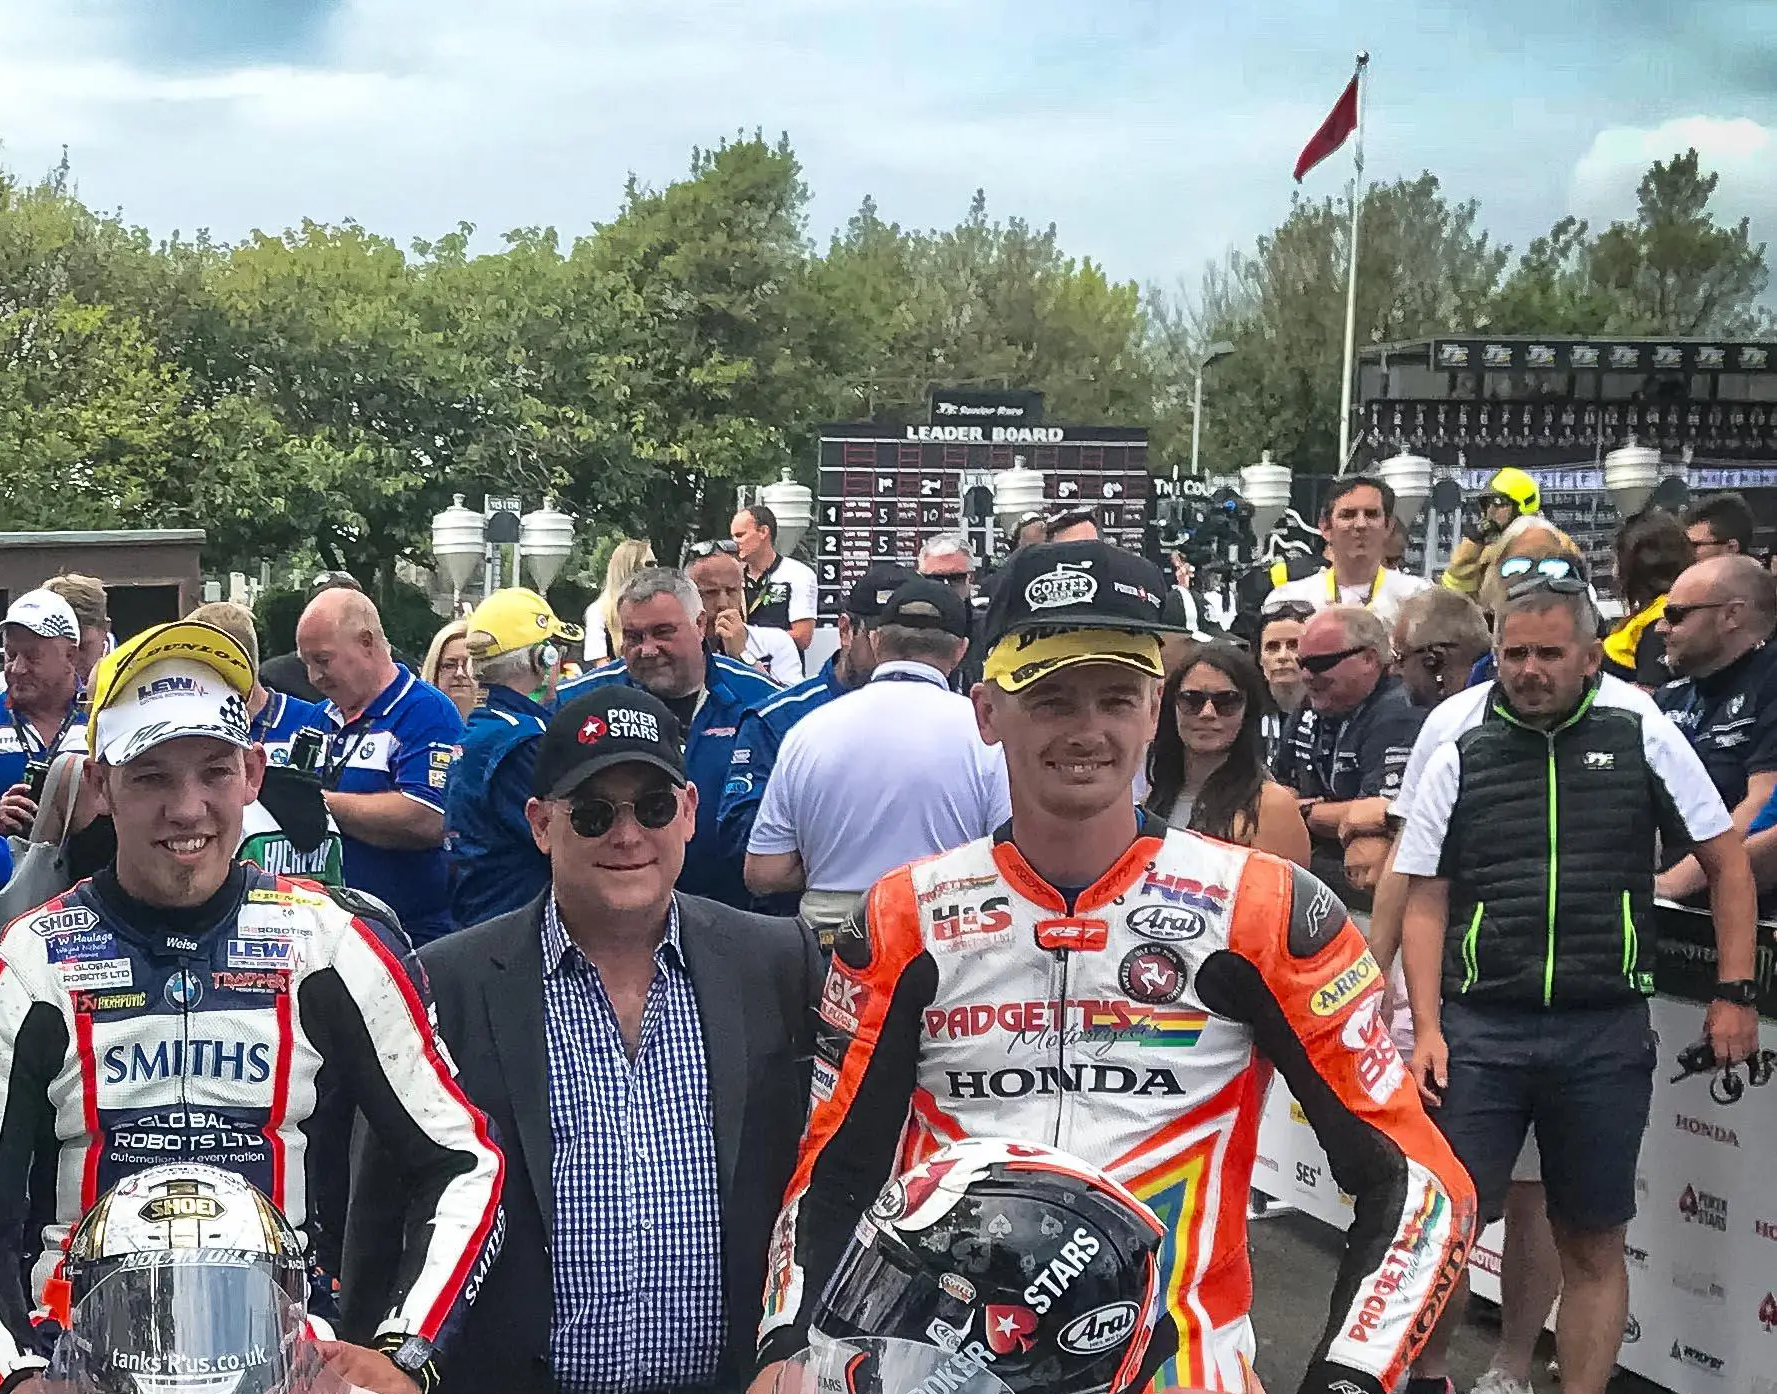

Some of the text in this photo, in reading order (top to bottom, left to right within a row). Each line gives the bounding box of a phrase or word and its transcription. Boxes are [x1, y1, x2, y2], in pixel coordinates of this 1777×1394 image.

[906, 426, 1064, 442] LEADER BOARD
[827, 507, 837, 523] 1
[878, 508, 889, 524] 5
[825, 536, 837, 551] 2
[878, 536, 889, 553] 5
[824, 564, 835, 580] 3
[1031, 578, 1088, 597] COFFEE
[607, 708, 658, 728] POKER
[609, 723, 659, 742] STARS
[39, 912, 89, 934] SHOEI
[1133, 909, 1197, 932] Arai
[1040, 925, 1105, 939] RST
[229, 942, 290, 958] LEW
[63, 970, 130, 982] ROBOTS LTD
[103, 1040, 271, 1085] SMITHS
[946, 1064, 1186, 1098] HONDA
[137, 1112, 232, 1130] GLOBAL
[1675, 1114, 1742, 1148] HONDA
[114, 1132, 264, 1151] ROBOTS LTD
[197, 1153, 228, 1165] every
[230, 1152, 265, 1163] nation
[1296, 1161, 1317, 1187] SES
[150, 1198, 218, 1217] SHOEI
[1023, 1227, 1100, 1315] STARS
[1079, 1308, 1132, 1343] Arai
